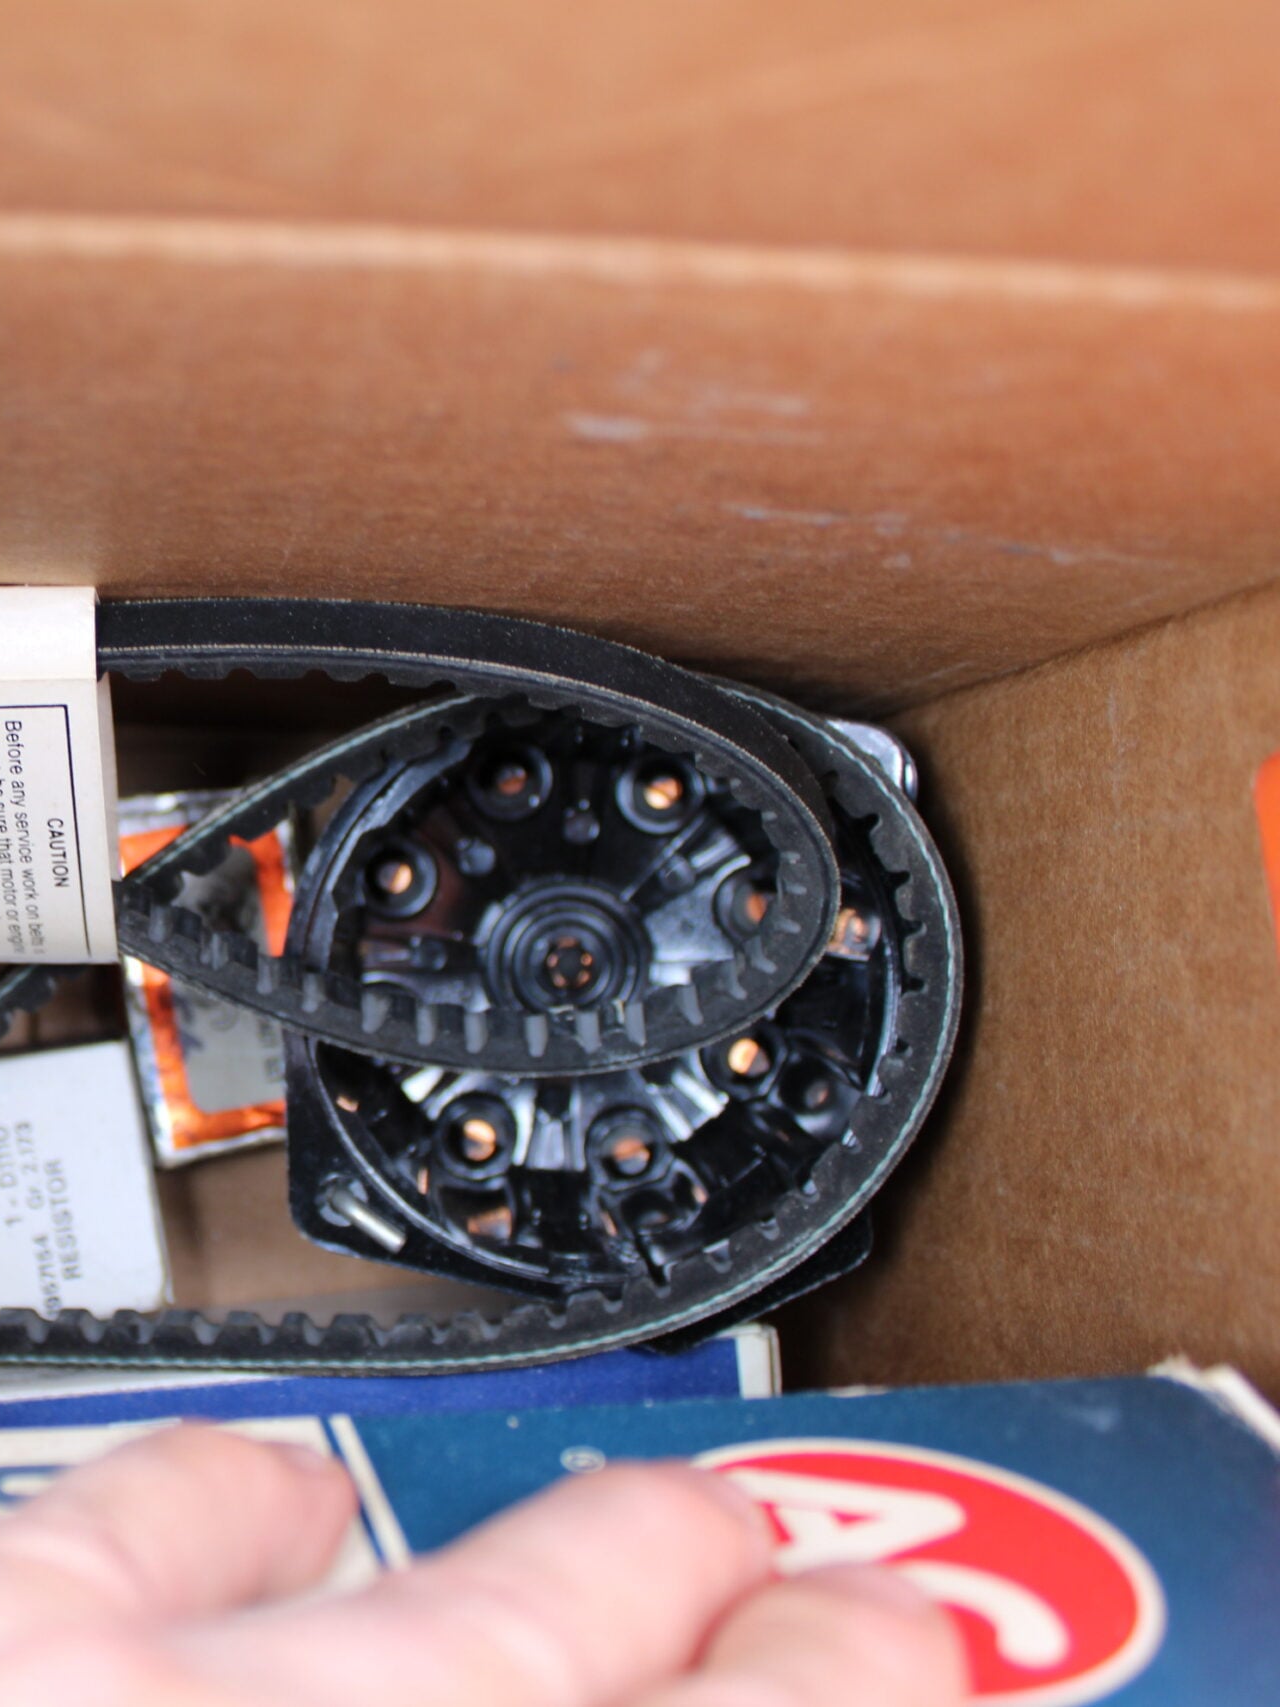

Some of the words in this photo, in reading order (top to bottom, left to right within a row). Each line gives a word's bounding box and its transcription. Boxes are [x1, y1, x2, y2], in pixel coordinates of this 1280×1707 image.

[5, 721, 23, 774] Before
[10, 781, 26, 807] any
[14, 812, 33, 863] service
[47, 818, 69, 887] CAUTION
[1, 869, 19, 905] motor
[22, 869, 38, 900] work
[7, 910, 20, 921] or
[26, 905, 39, 919] on
[43, 1160, 83, 1280] RESISTOR
